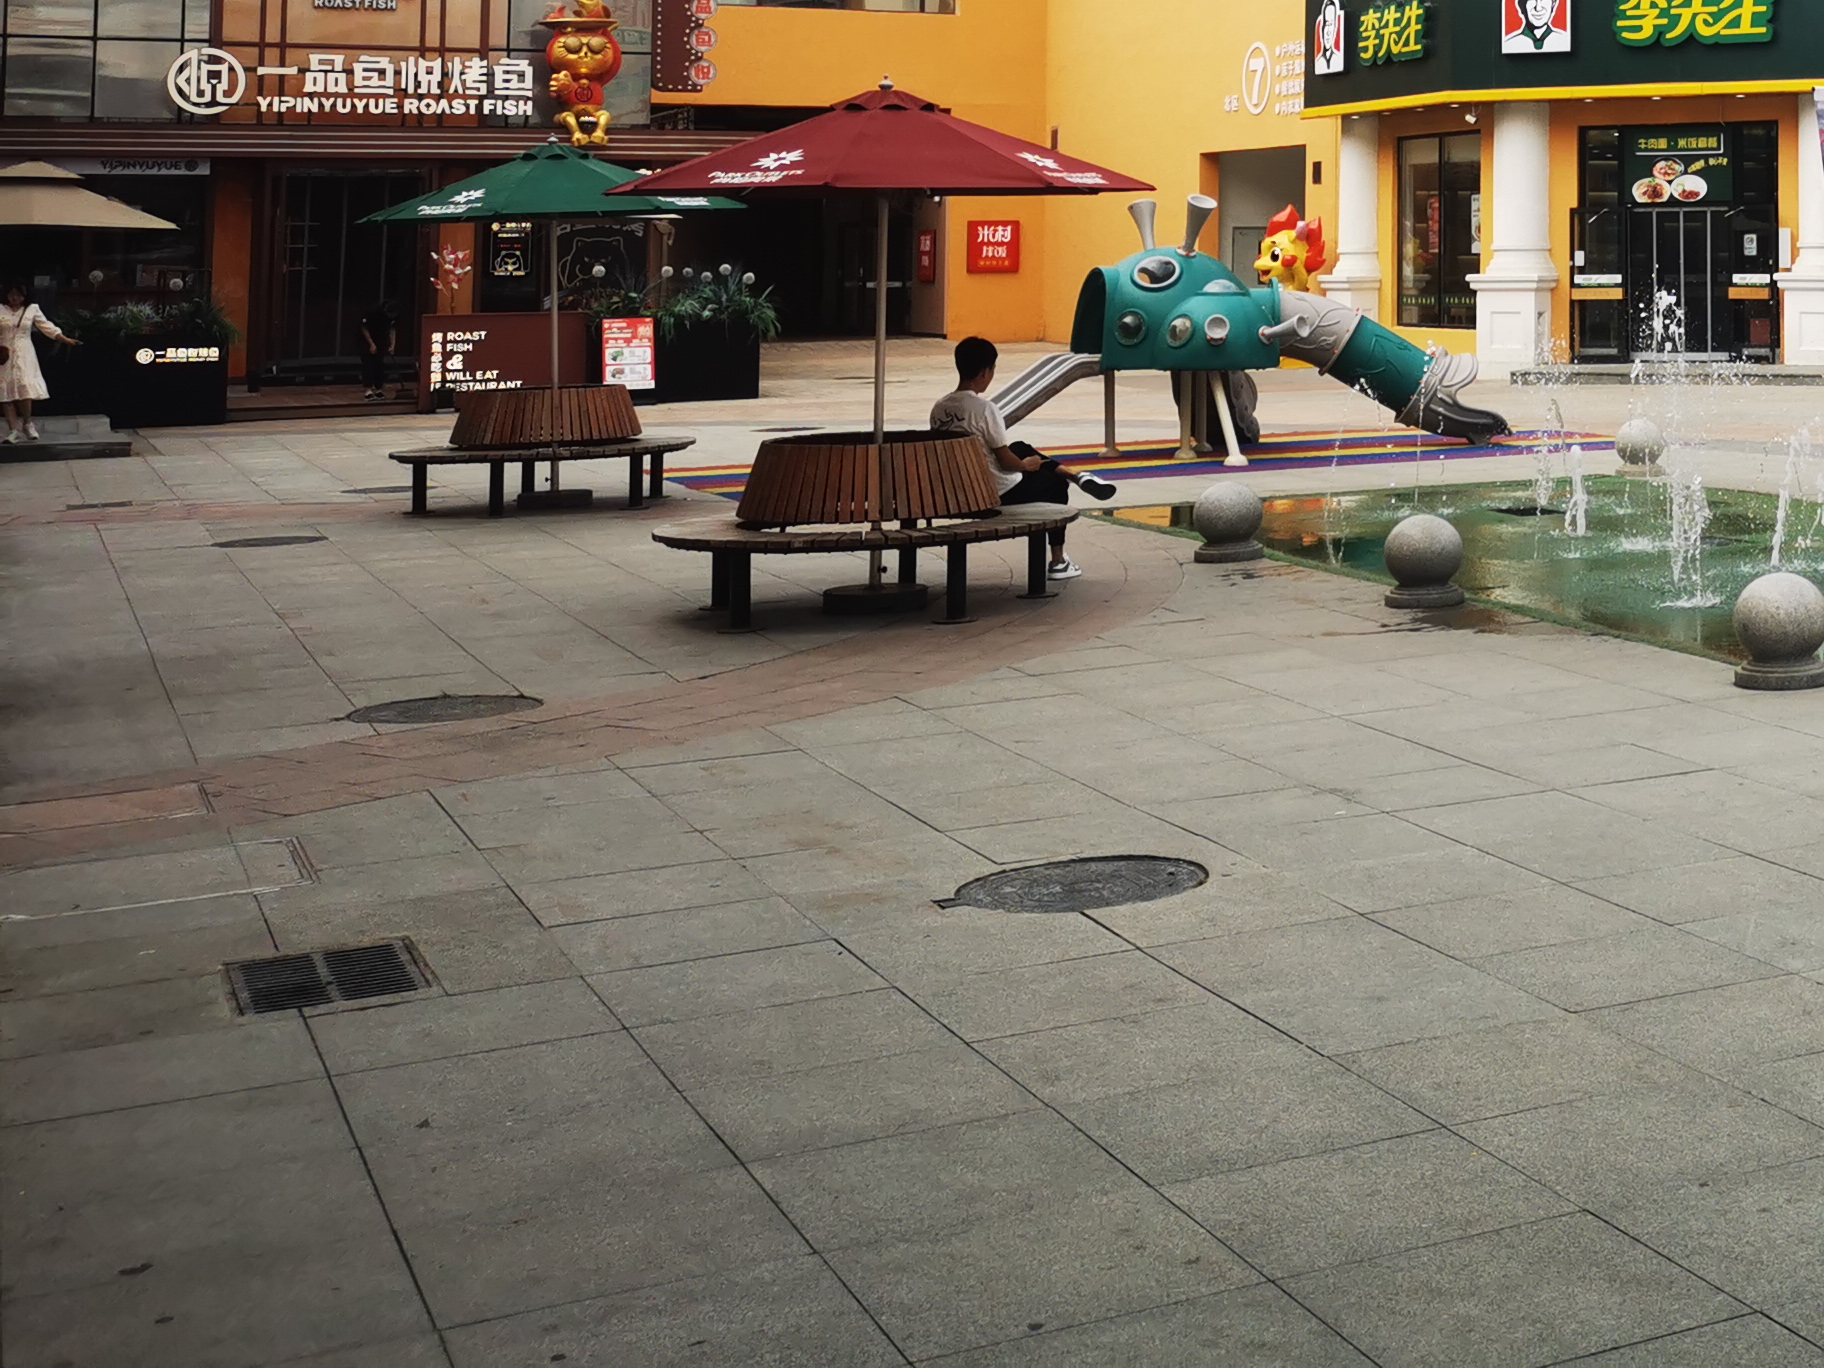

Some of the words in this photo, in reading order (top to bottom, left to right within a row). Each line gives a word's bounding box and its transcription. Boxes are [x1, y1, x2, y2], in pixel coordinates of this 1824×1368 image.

[256, 53, 533, 97] 一品鱼悦烤鱼
[256, 96, 399, 114] YIPINYUYUE
[403, 98, 478, 115] ROAST
[483, 99, 533, 116] FISH
[977, 225, 1012, 243] 米村
[446, 331, 487, 341] ROAST
[446, 342, 473, 352] FISH
[446, 353, 463, 370] &
[445, 371, 473, 381] WILL
[475, 370, 500, 380] EAT
